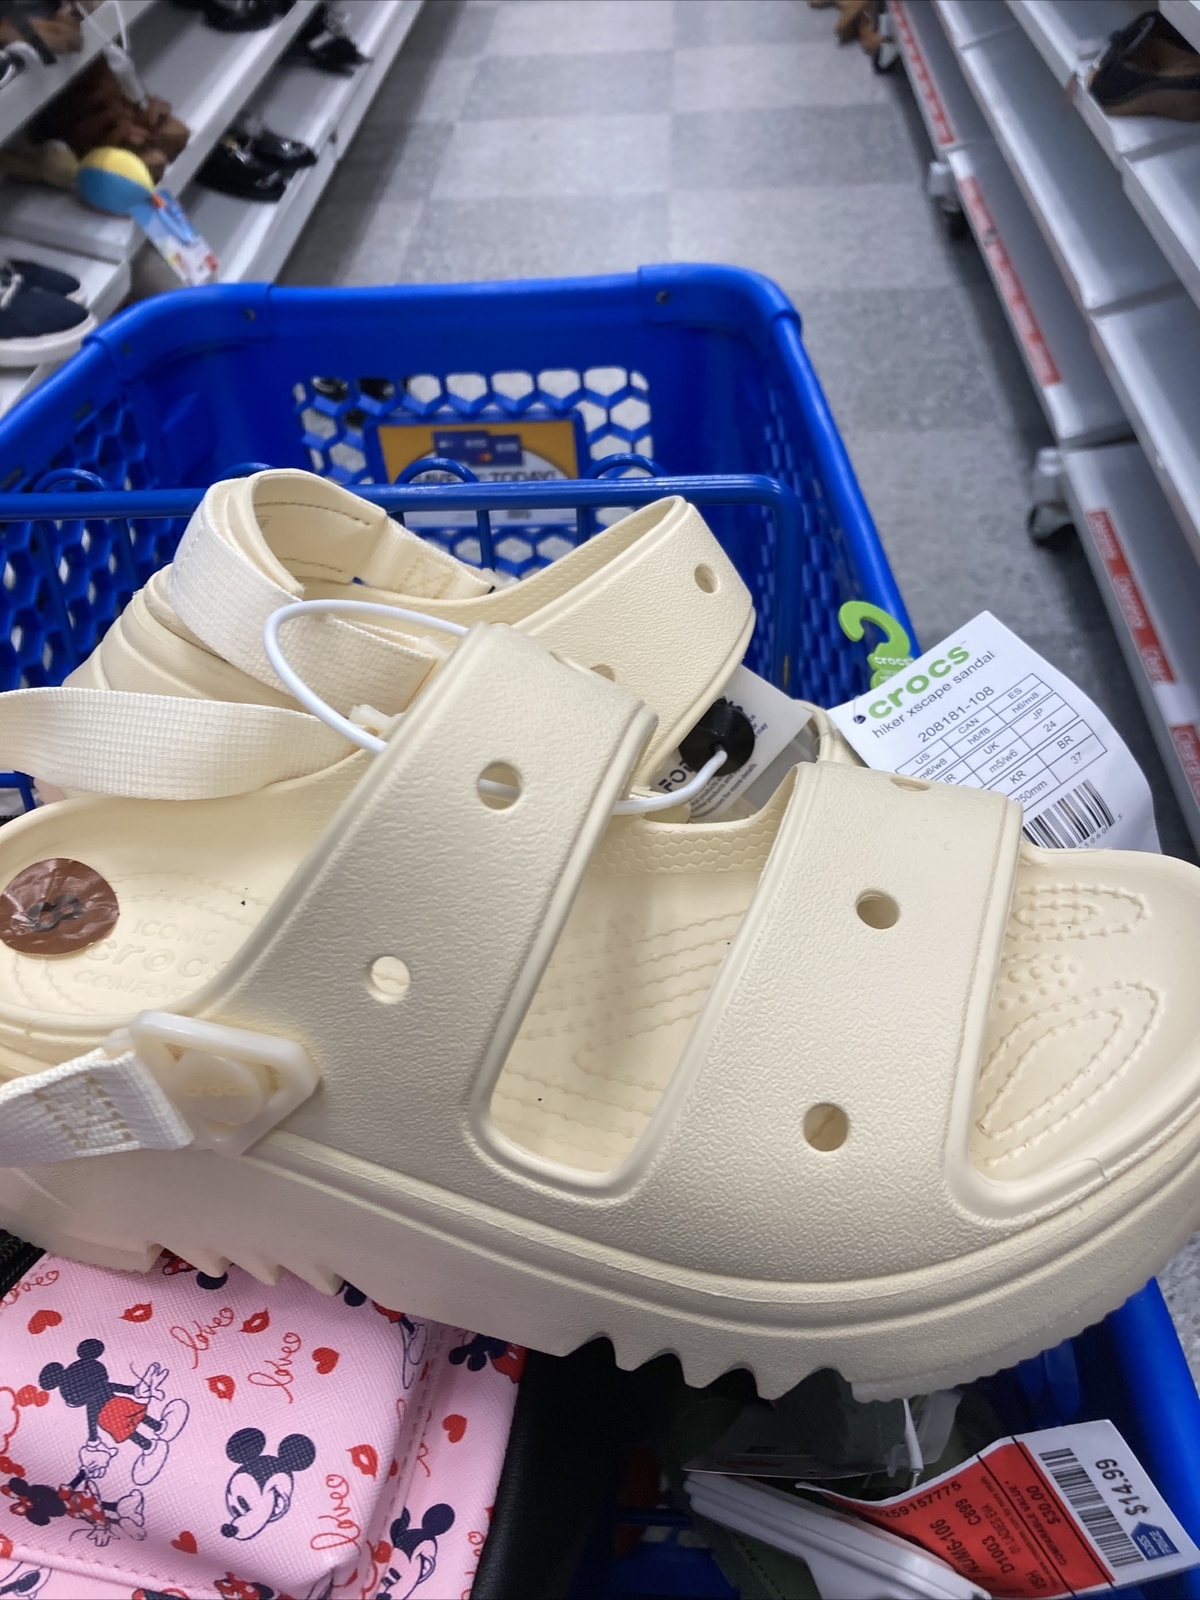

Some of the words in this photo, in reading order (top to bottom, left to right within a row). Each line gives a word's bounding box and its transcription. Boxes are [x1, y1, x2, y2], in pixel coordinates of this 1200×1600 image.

[868, 645, 970, 719] crocs
[872, 714, 905, 738] hiker
[907, 682, 952, 717] xscape
[952, 650, 995, 684] sandal
[915, 753, 930, 765] US
[958, 717, 979, 735] CAN
[1007, 688, 1022, 700] ES
[918, 686, 994, 743] 208181-108
[983, 741, 1000, 755] UK
[1033, 708, 1043, 720] JP
[989, 749, 1018, 774] m5/w6
[1043, 720, 1057, 732] 24
[1009, 770, 1027, 784] KR
[1056, 735, 1074, 750] BR
[1070, 752, 1082, 764] 37
[72, 969, 195, 1000] COMFOR
[1008, 1484, 1031, 1512] VALUE
[1026, 1485, 1061, 1525] $30.00
[1095, 1458, 1150, 1516] $14.99
[954, 1497, 982, 1527] C899
[981, 1534, 1015, 1575] D1003
[1026, 1512, 1067, 1567] COMPARABLE
